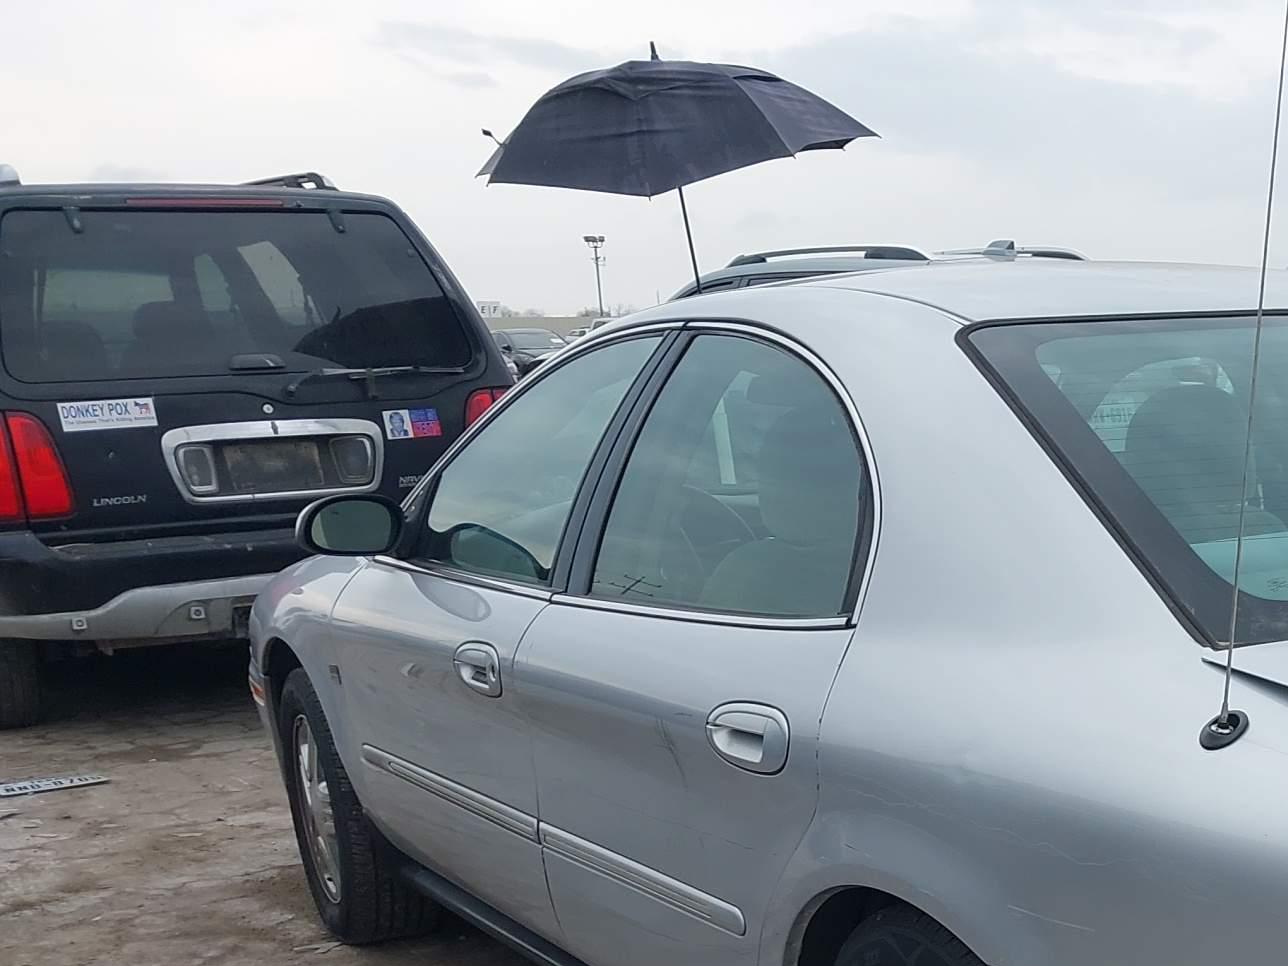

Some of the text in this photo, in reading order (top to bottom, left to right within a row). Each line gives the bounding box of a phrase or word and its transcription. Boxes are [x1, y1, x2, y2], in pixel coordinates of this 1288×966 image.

[60, 401, 131, 419] DONKEY POX
[92, 494, 148, 507] LINCOLN
